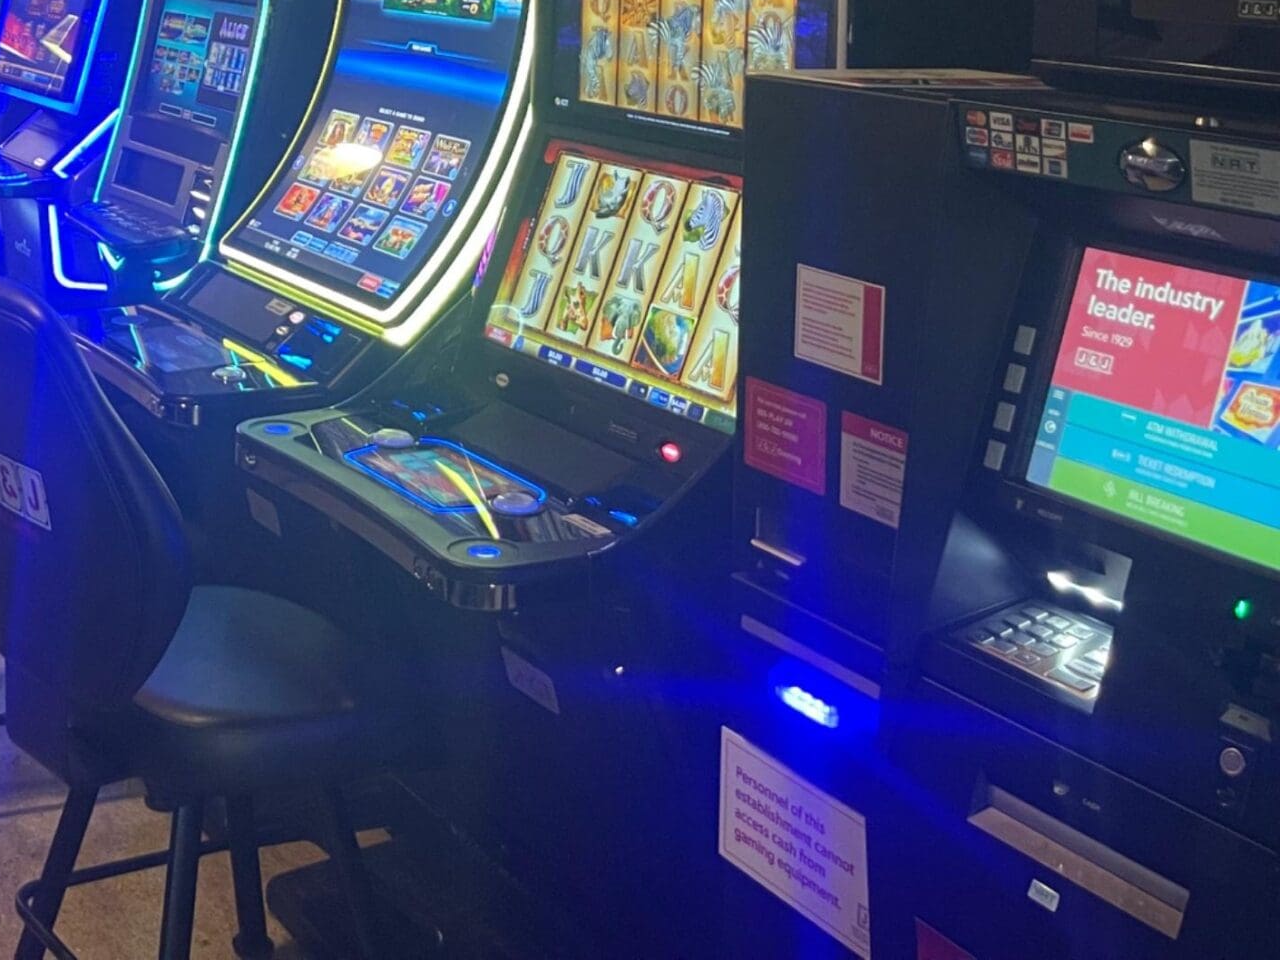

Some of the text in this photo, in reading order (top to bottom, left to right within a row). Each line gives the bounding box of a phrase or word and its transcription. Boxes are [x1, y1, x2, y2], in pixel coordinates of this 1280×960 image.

[640, 180, 676, 235] Q
[537, 214, 570, 268] Q
[574, 225, 615, 281] K
[617, 238, 660, 294] K
[661, 252, 701, 311] A
[1096, 268, 1225, 321] The industry
[1081, 325, 1133, 348] Since 1929
[1087, 294, 1156, 331] leader.
[688, 328, 730, 390] A
[870, 427, 904, 449] NOTICE
[1138, 454, 1163, 469] TICKET
[736, 765, 825, 835] Personnel of this
[734, 807, 826, 878] access cash from
[735, 789, 855, 876] establishment cannot
[734, 827, 842, 910] gaming equipment.
